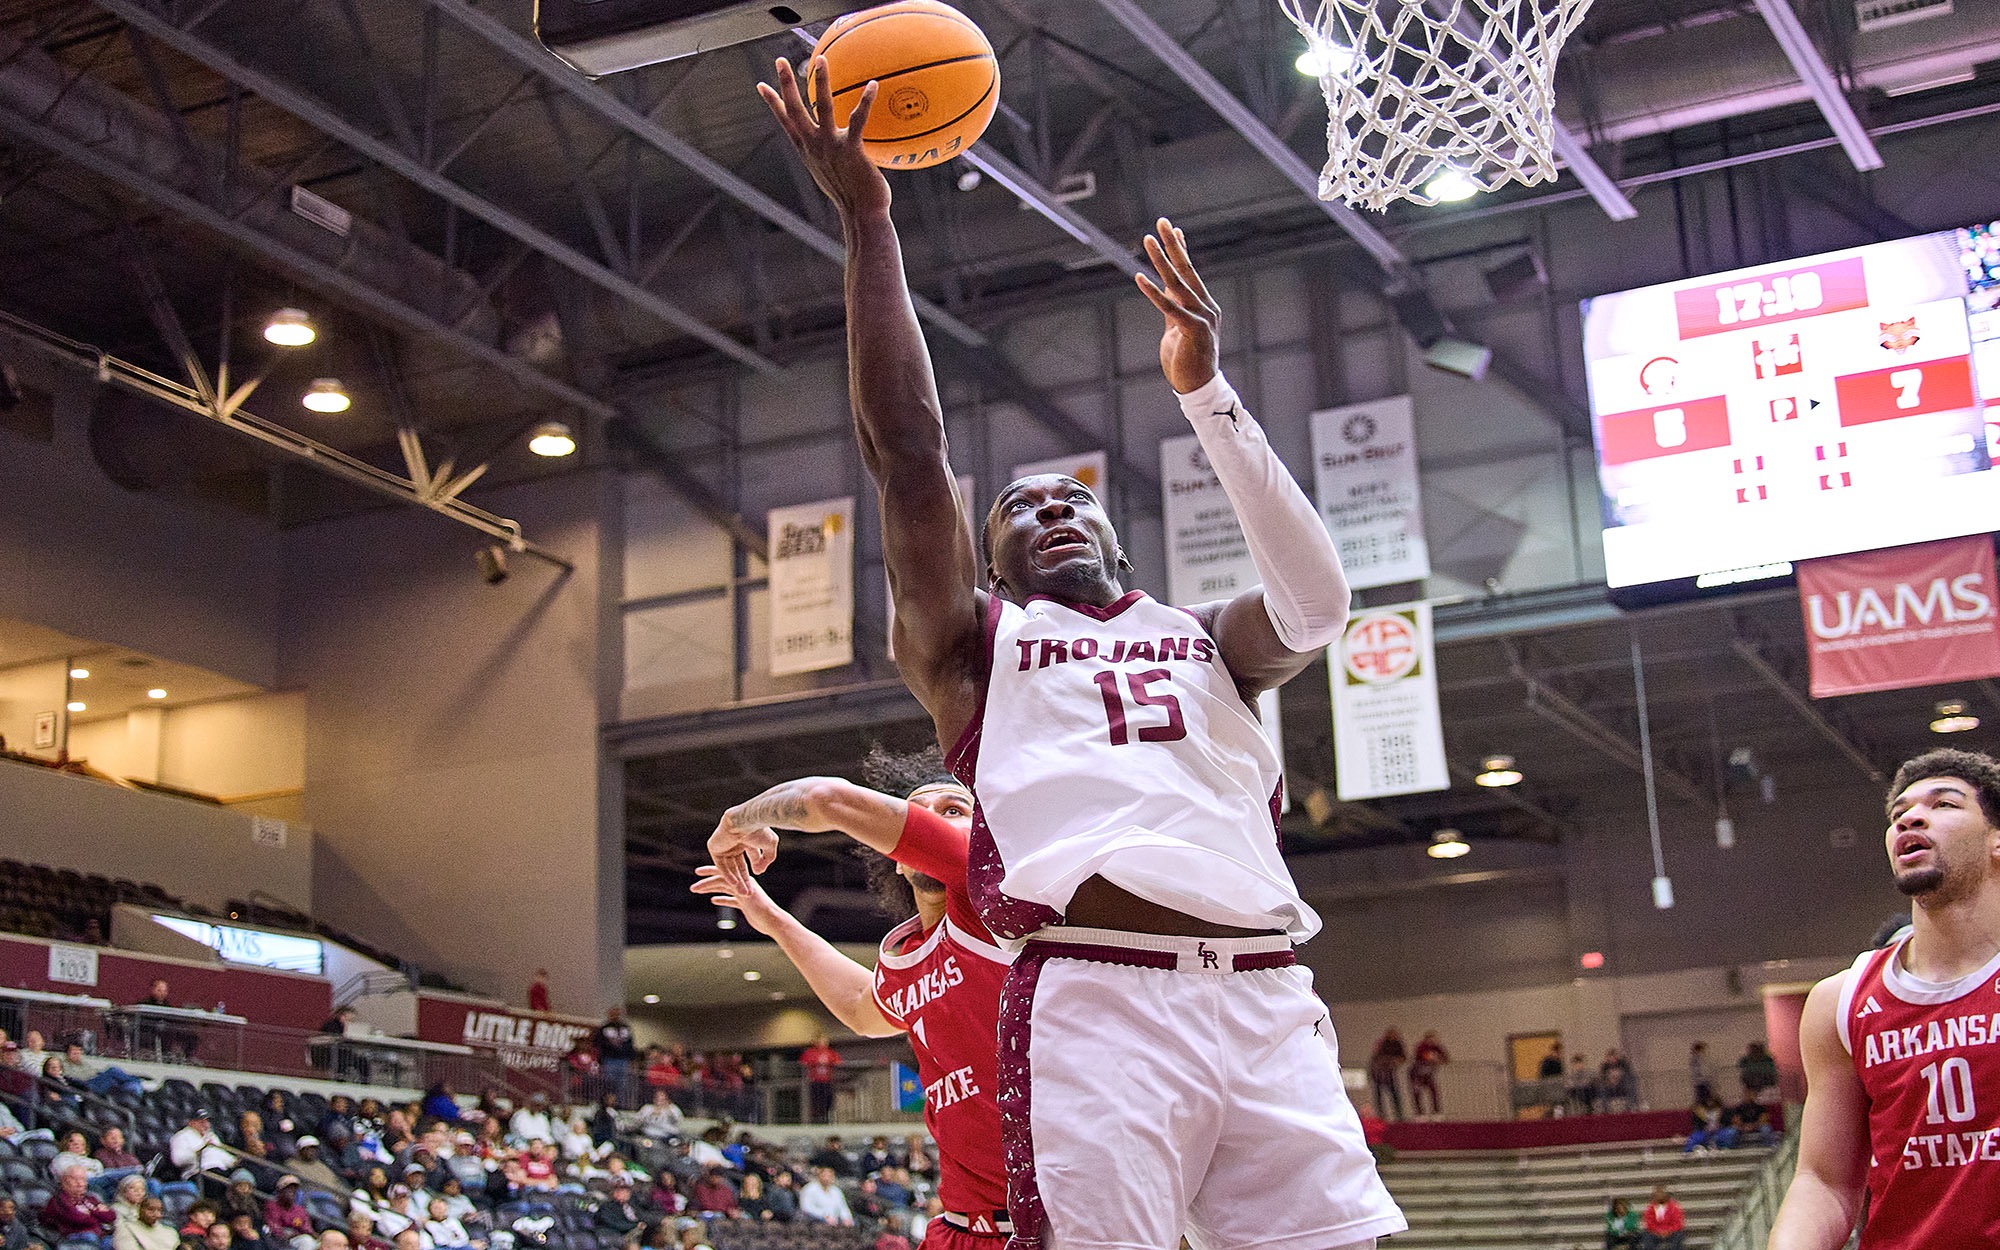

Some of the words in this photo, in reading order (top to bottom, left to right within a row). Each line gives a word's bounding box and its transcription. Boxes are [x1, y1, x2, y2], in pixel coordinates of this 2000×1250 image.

[1889, 368, 1922, 409] 7
[1808, 572, 1991, 639] UAMS
[1016, 637, 1216, 672] TROJANS
[1093, 669, 1187, 746] 15
[59, 959, 90, 983] 103
[1198, 942, 1219, 969] LR
[463, 1010, 533, 1046] LITTLE
[912, 1016, 929, 1050] 1
[1920, 1056, 1976, 1125] 10
[1903, 1127, 2000, 1170] STATE
